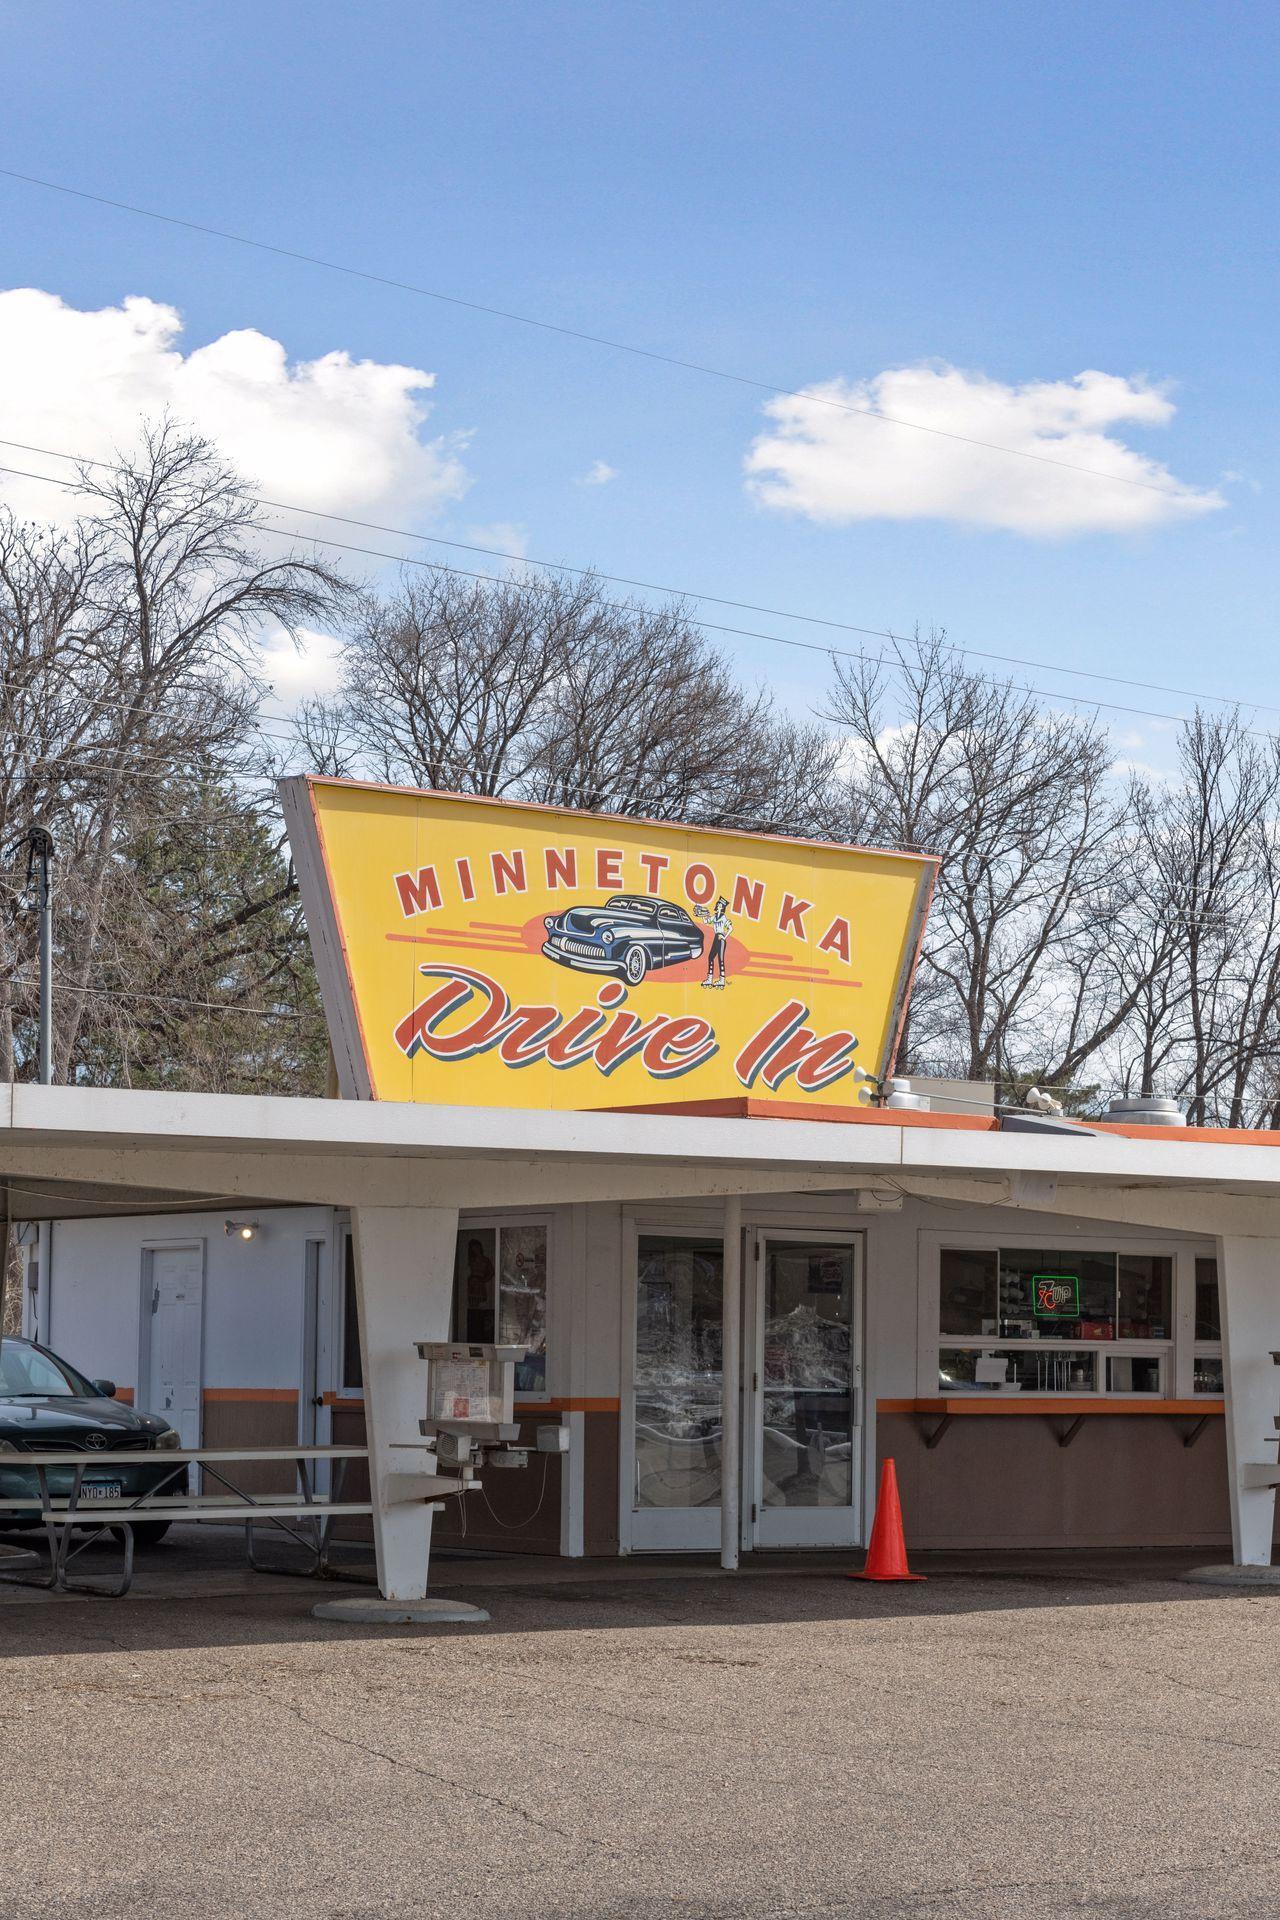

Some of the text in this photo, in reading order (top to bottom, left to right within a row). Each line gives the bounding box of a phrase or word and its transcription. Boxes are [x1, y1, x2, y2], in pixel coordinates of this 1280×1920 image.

[393, 848, 852, 966] MINNETONKA
[393, 962, 859, 1093] Drive In
[104, 1486, 119, 1498] 185
